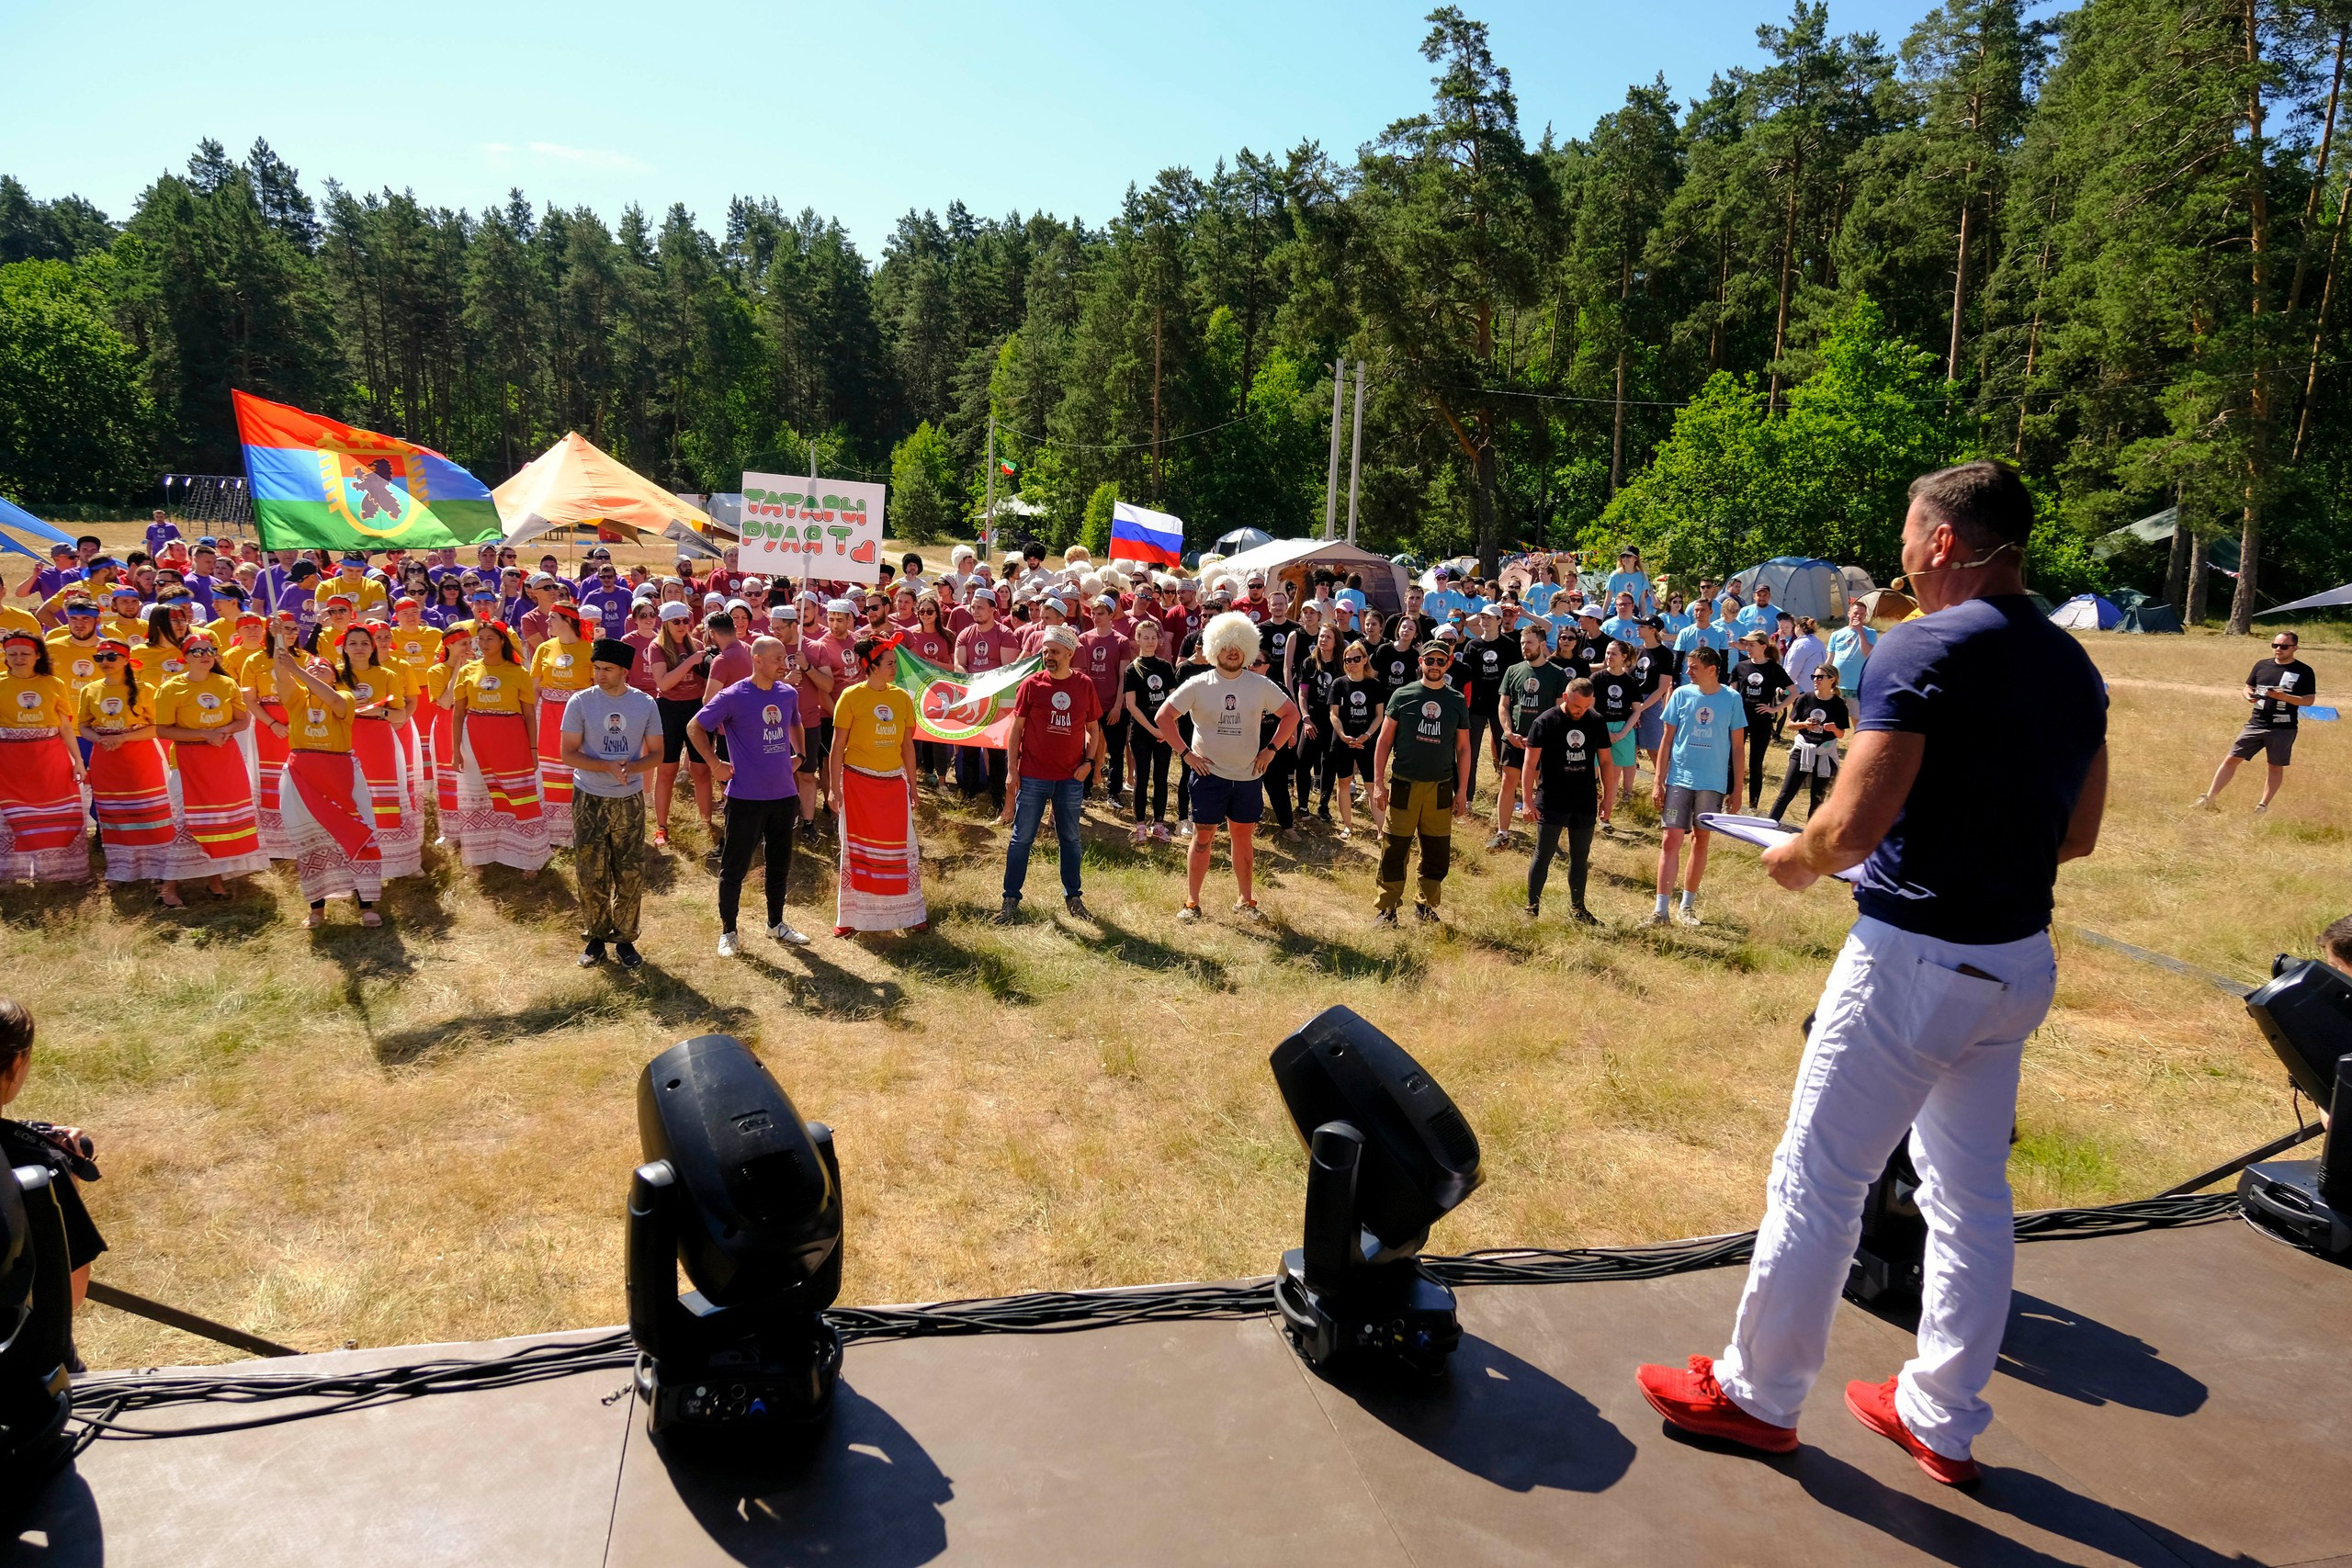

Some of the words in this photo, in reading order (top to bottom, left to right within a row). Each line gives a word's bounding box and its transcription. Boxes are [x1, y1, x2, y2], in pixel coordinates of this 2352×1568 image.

[743, 488, 866, 526] ТАТАРЫ
[1666, 808, 1678, 818] 28
[15, 1129, 37, 1144] EOS
